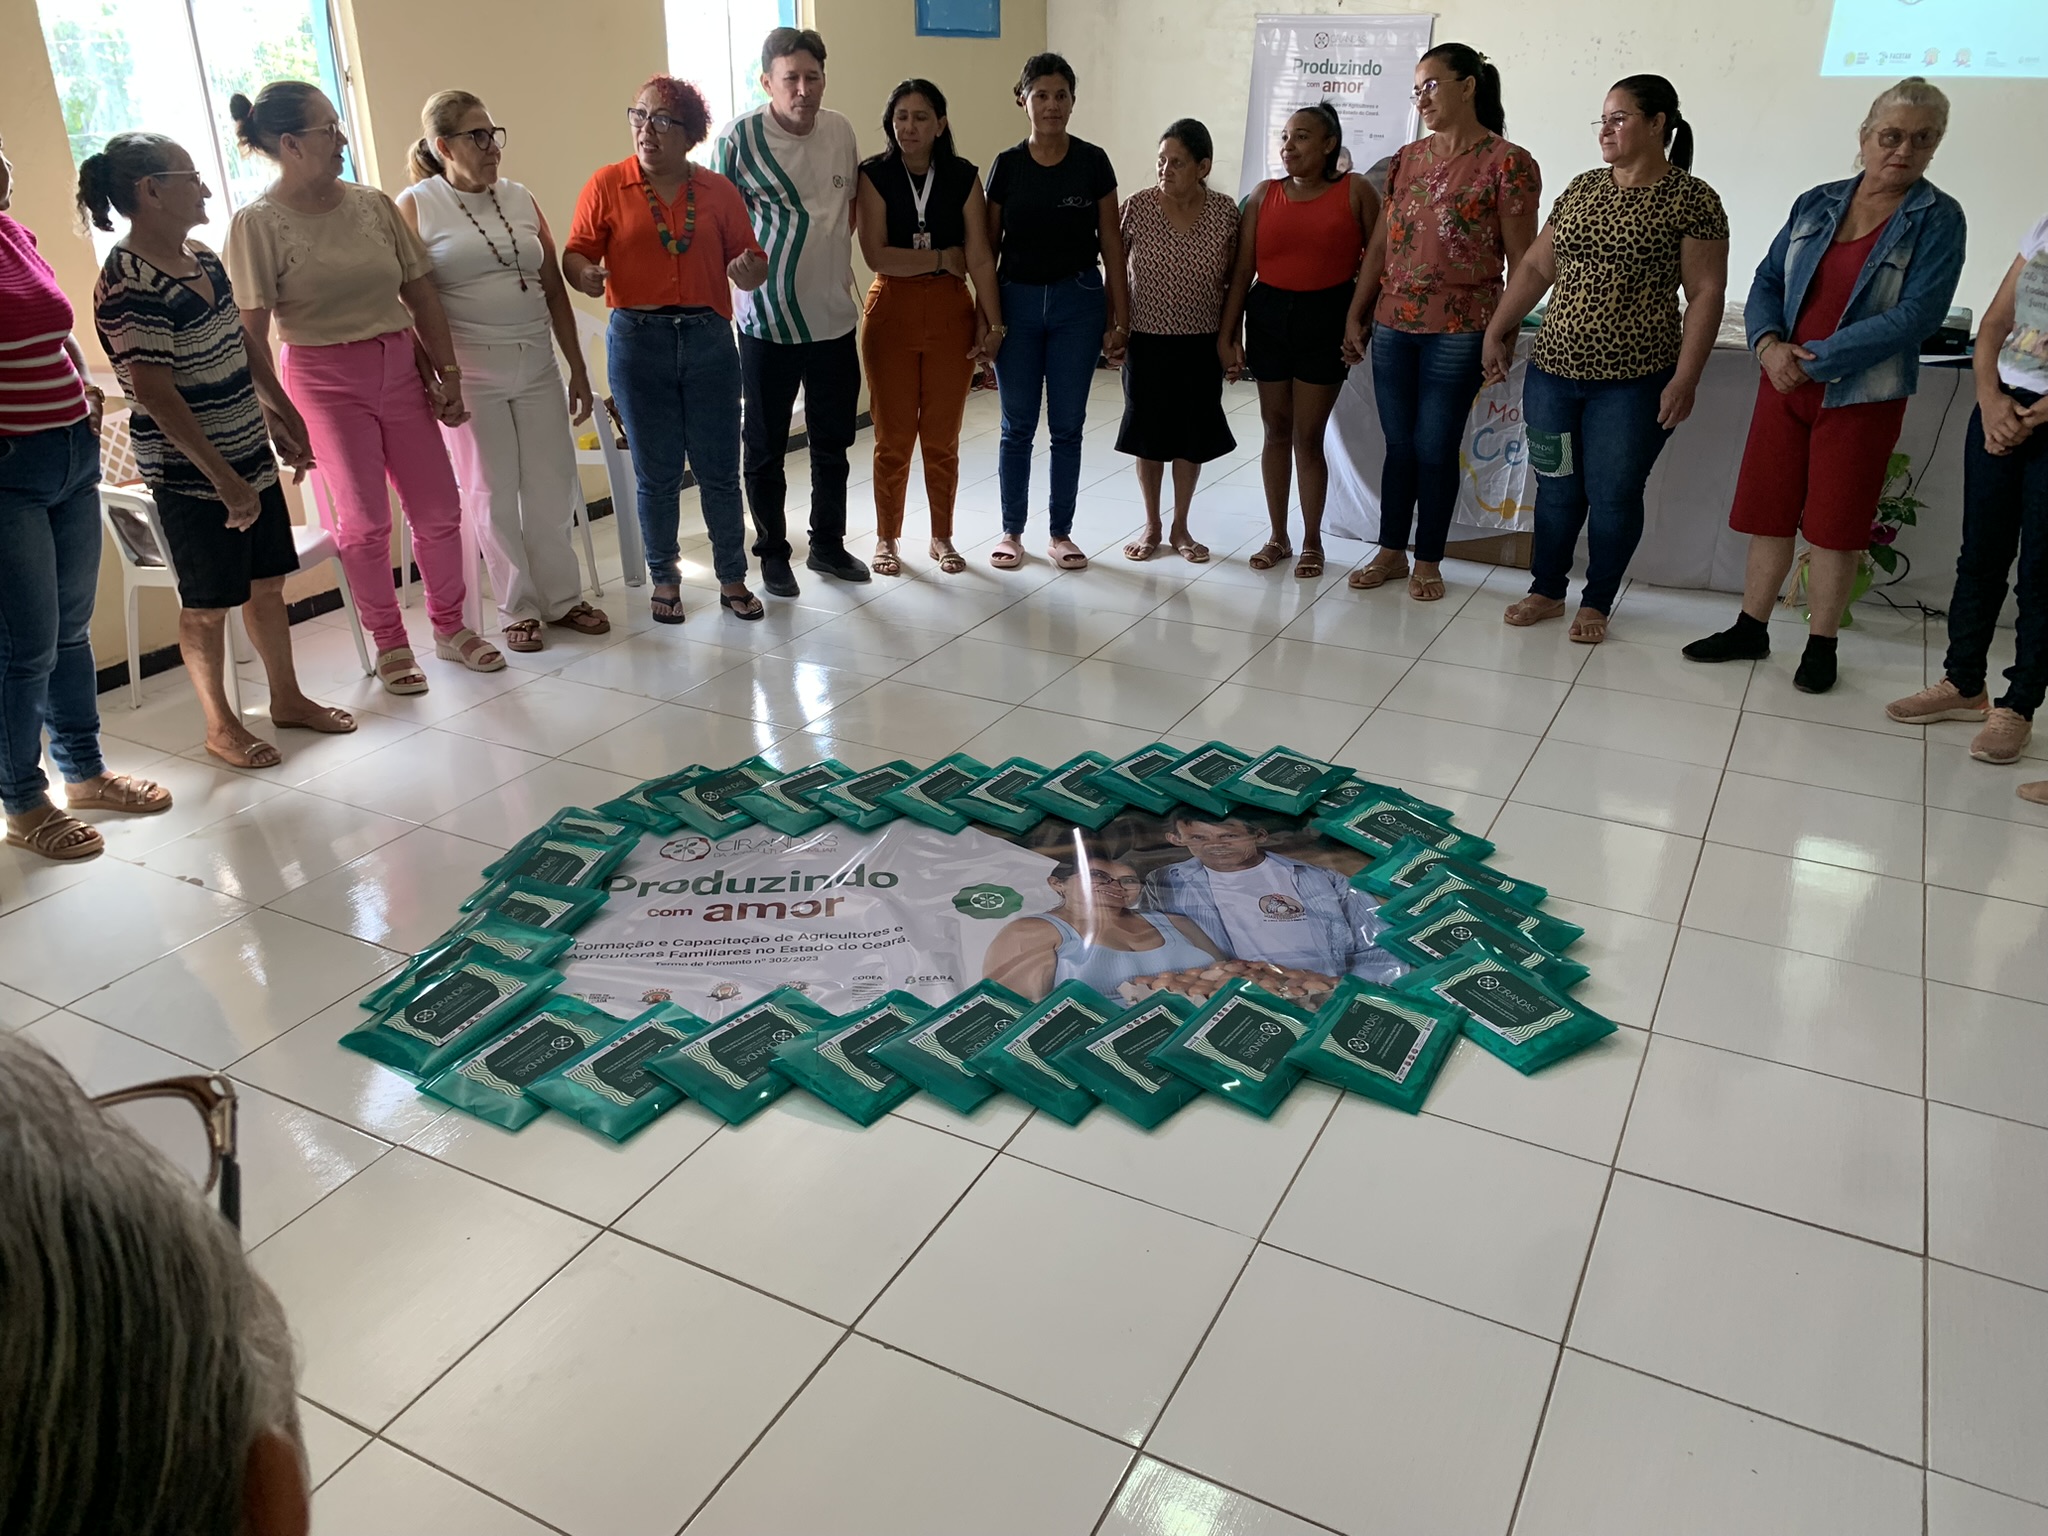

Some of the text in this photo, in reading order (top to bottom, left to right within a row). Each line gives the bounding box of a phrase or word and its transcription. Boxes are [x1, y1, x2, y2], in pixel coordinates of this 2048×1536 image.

[1293, 58, 1382, 76] Produzindo
[1322, 80, 1364, 94] amor
[1487, 400, 1520, 423] Mo
[1472, 427, 1523, 466] Ce
[602, 863, 899, 898] Produzindo
[647, 896, 845, 922] com amor
[566, 934, 911, 961] Agricultoras Familiares no Estado do Ceará.
[574, 925, 904, 951] Formação e Capacitação de Agricultores e
[706, 958, 752, 967] Fomento
[768, 955, 819, 964] 302/2023
